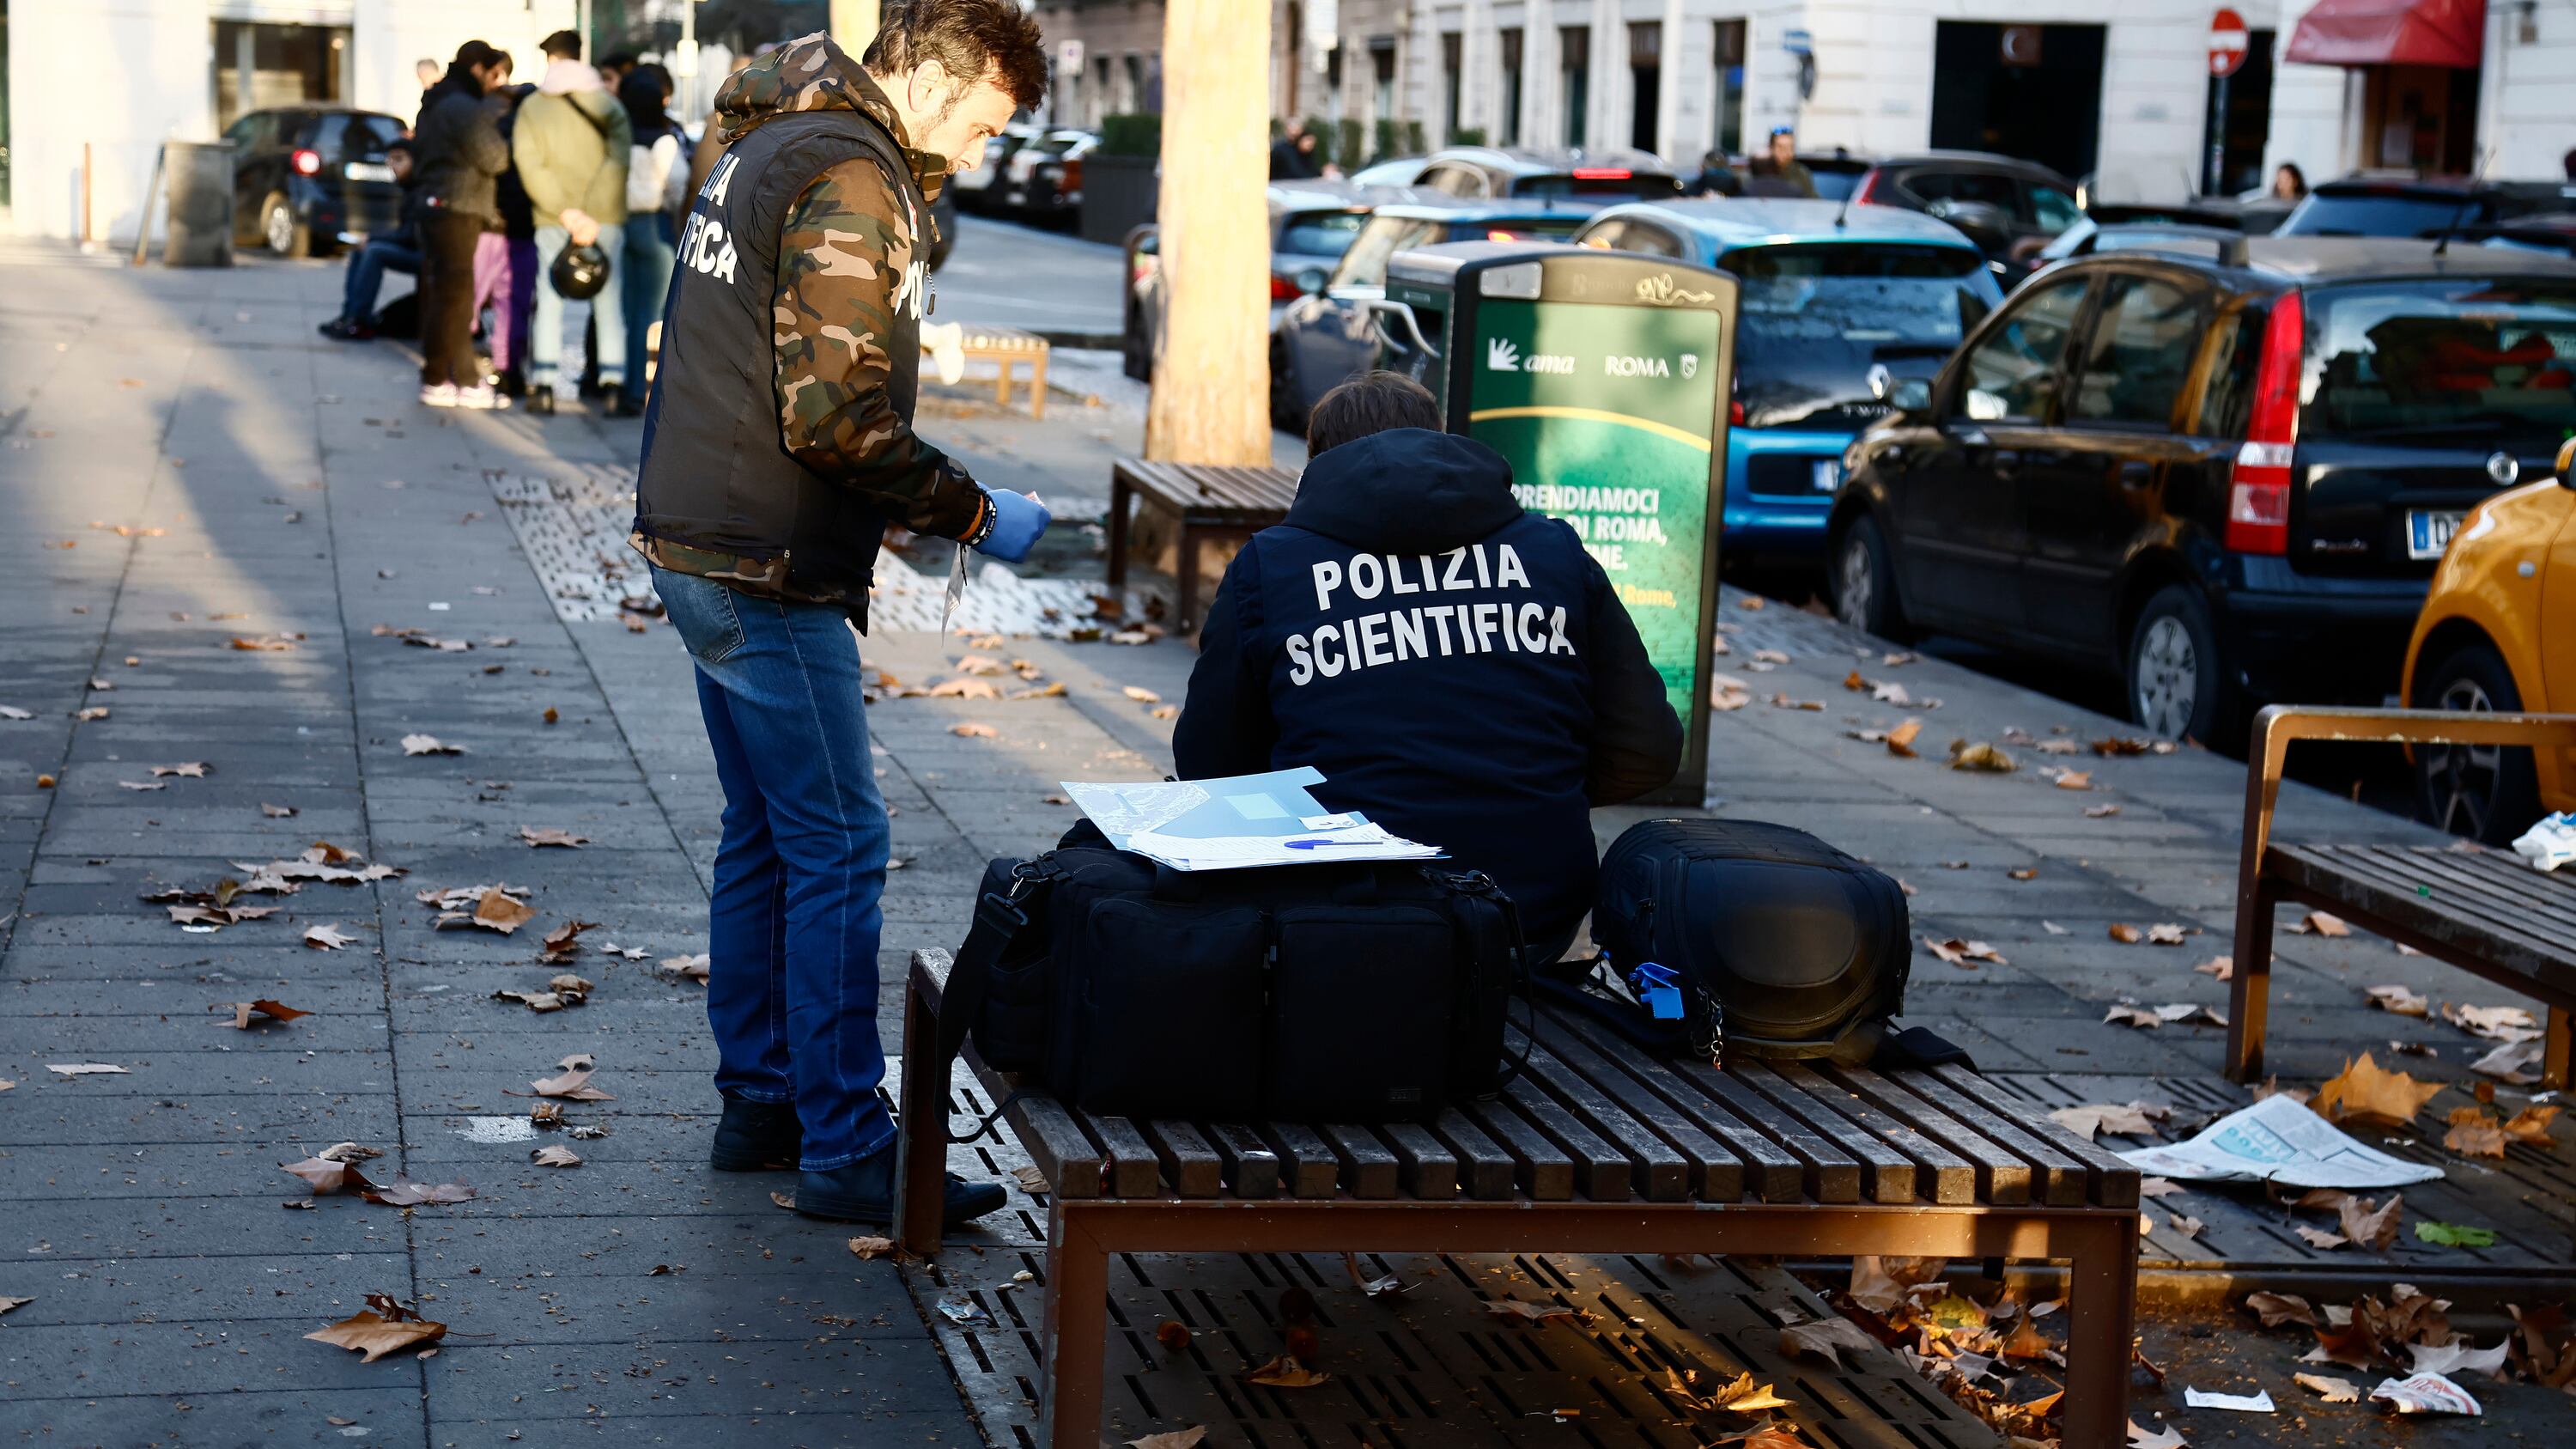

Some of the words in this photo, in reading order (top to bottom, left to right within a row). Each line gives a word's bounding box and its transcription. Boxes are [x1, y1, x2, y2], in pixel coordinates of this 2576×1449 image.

[1604, 355, 1670, 379] ROMA
[1594, 515, 1668, 547] ROMA,
[1312, 544, 1532, 611] POLIZIA
[1286, 602, 1577, 686] SCIENTIFICA
